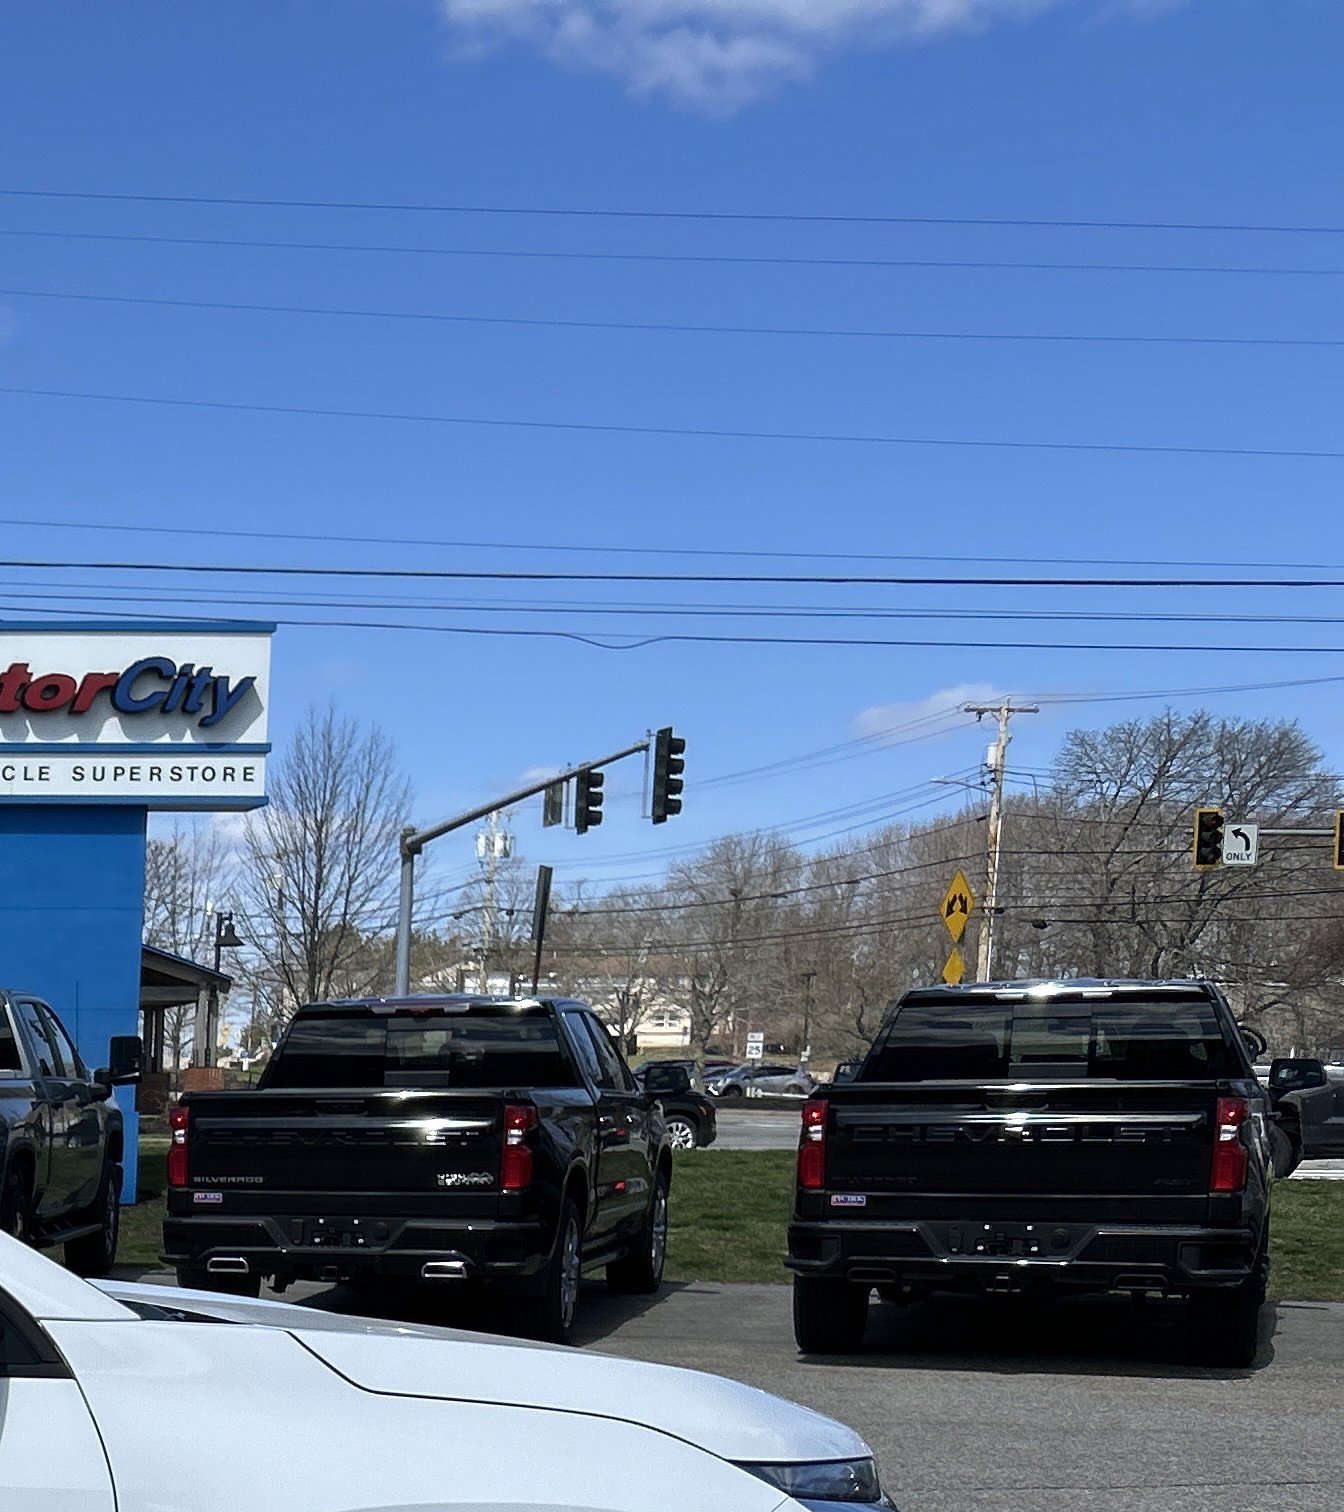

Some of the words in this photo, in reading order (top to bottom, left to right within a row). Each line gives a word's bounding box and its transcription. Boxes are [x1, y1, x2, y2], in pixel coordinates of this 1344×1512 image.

[72, 765, 256, 783] SUPERSTORE
[1225, 852, 1253, 861] ONLY
[747, 1045, 761, 1056] 25
[852, 1126, 1187, 1143] CHEVROLET
[193, 1175, 264, 1184] SILVERADO
